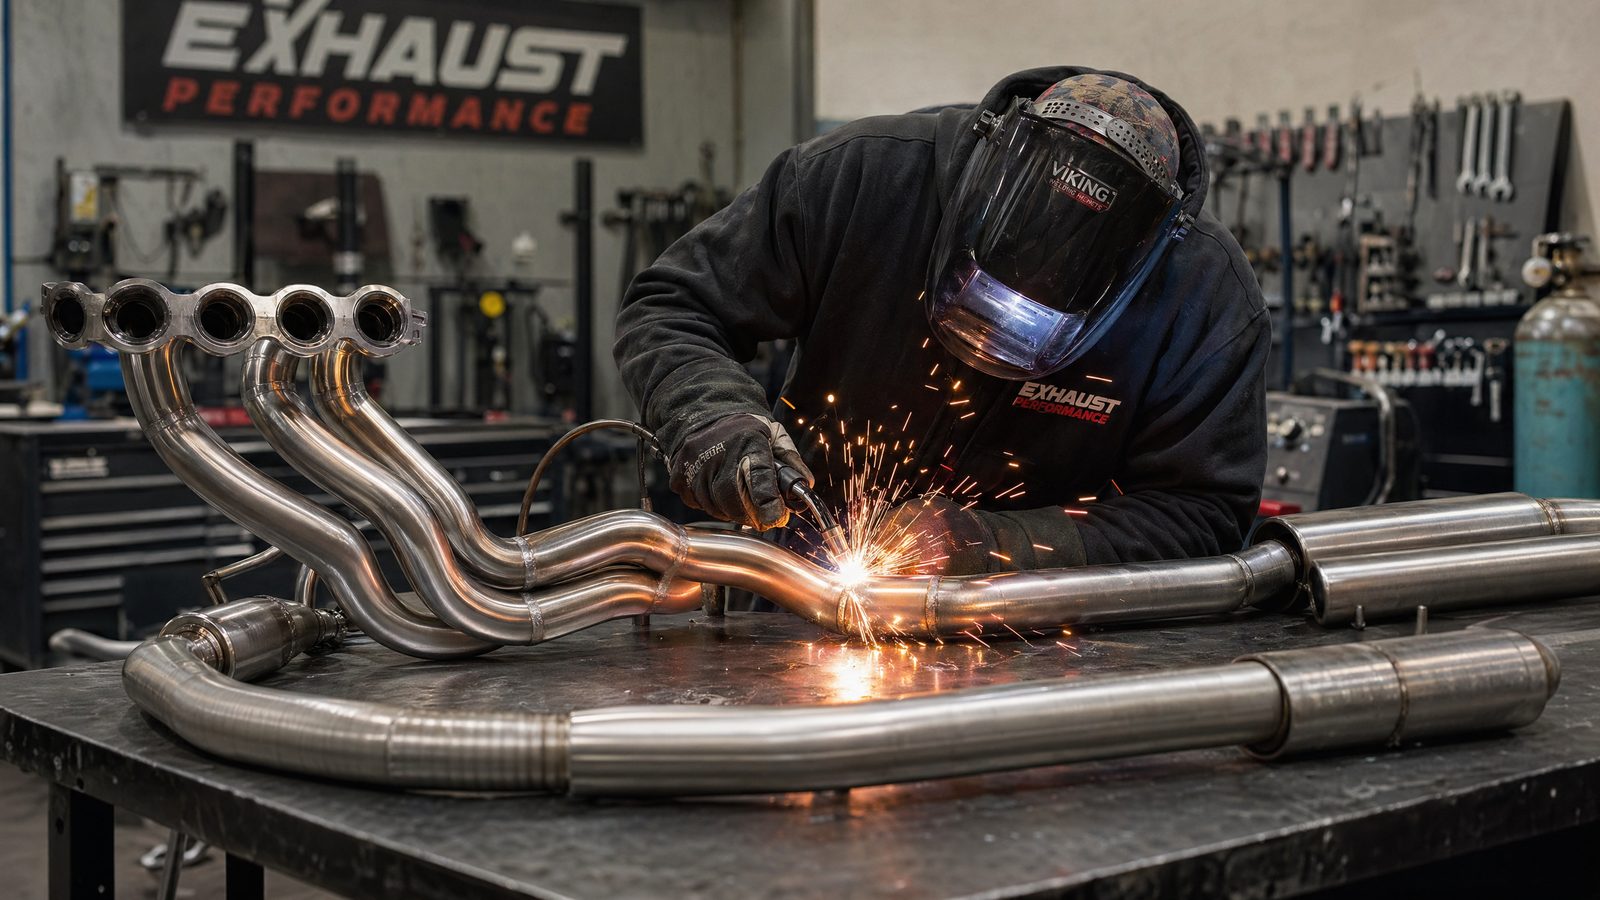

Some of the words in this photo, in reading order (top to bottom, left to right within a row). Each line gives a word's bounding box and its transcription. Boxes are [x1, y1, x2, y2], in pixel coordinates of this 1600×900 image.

[162, 0, 628, 96] EXHAUST
[162, 76, 593, 135] PERFORMANCE
[1052, 160, 1109, 202] VIKING
[1012, 396, 1110, 424] PERFORMANCE
[1018, 381, 1121, 413] EXHAUST
